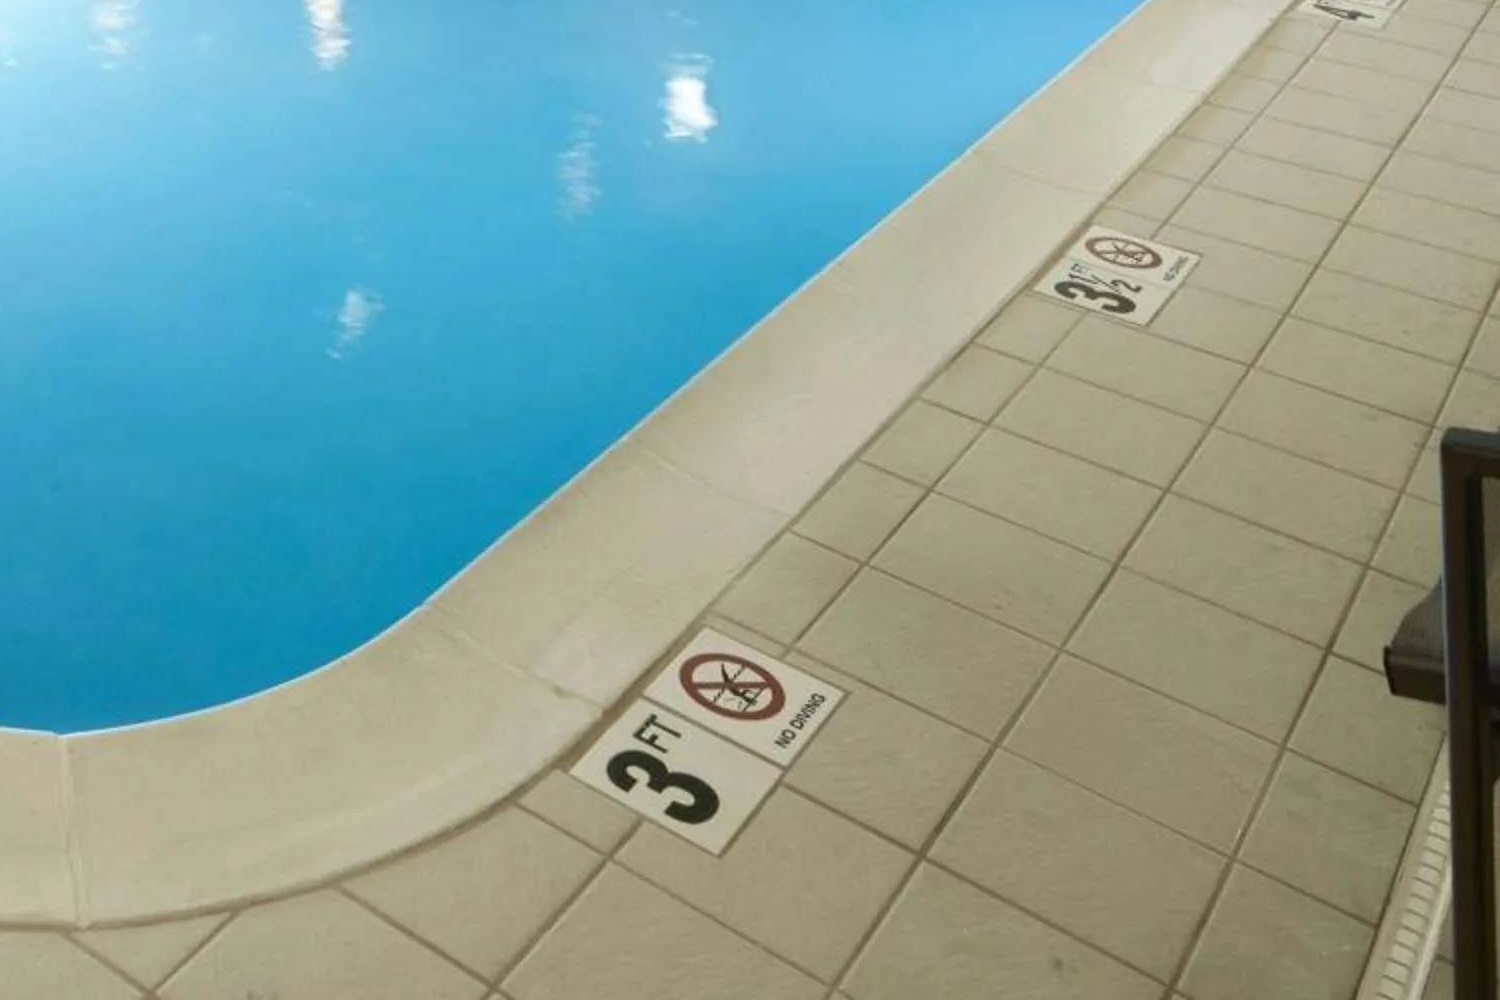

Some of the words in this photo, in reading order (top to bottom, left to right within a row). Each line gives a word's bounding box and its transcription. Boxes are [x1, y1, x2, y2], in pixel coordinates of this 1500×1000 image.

[631, 713, 683, 754] FT
[774, 729, 796, 748] NO
[789, 693, 825, 730] DIVING
[606, 749, 721, 825] 3
